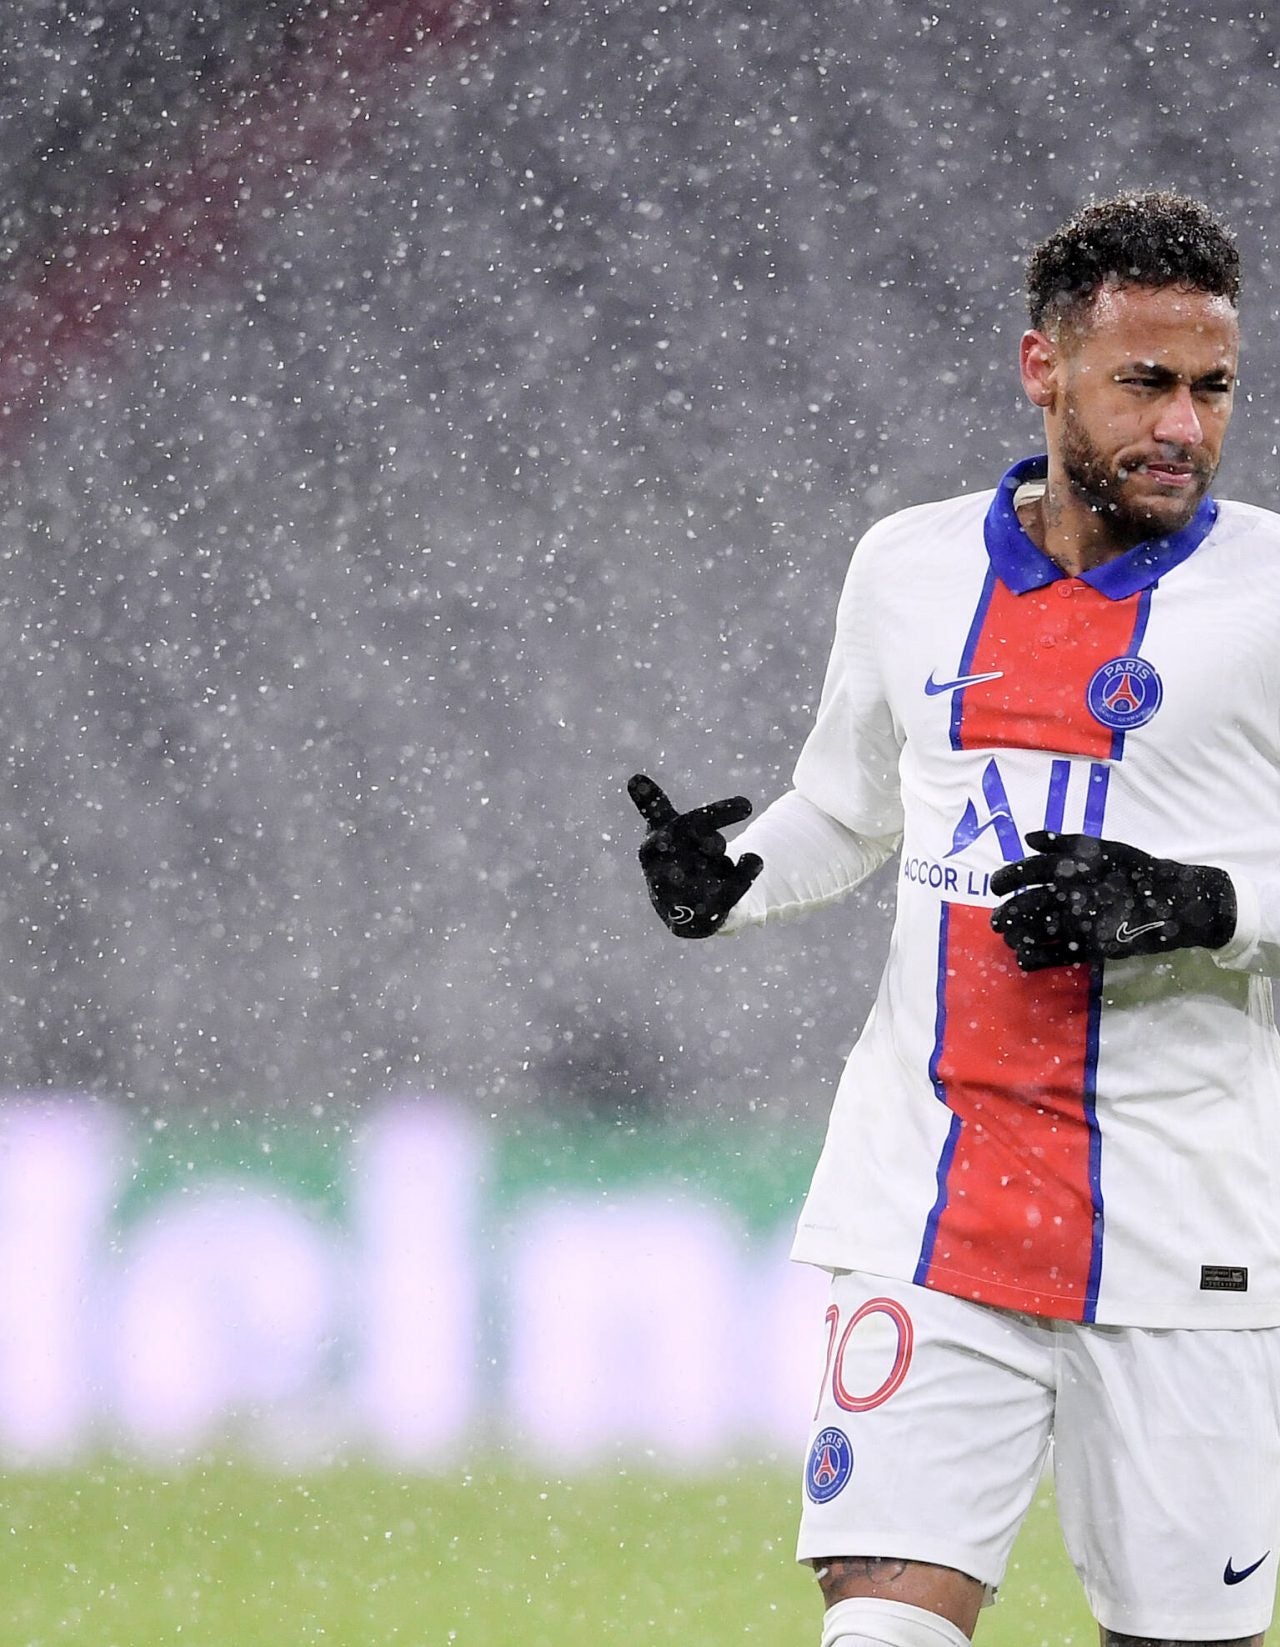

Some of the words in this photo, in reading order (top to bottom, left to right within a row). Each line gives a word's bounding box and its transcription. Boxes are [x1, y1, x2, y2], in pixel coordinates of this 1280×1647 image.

[1103, 661, 1151, 680] PARIS
[904, 856, 958, 892] ACCOR
[814, 1297, 914, 1422] 10
[814, 1433, 844, 1453] PARIS
